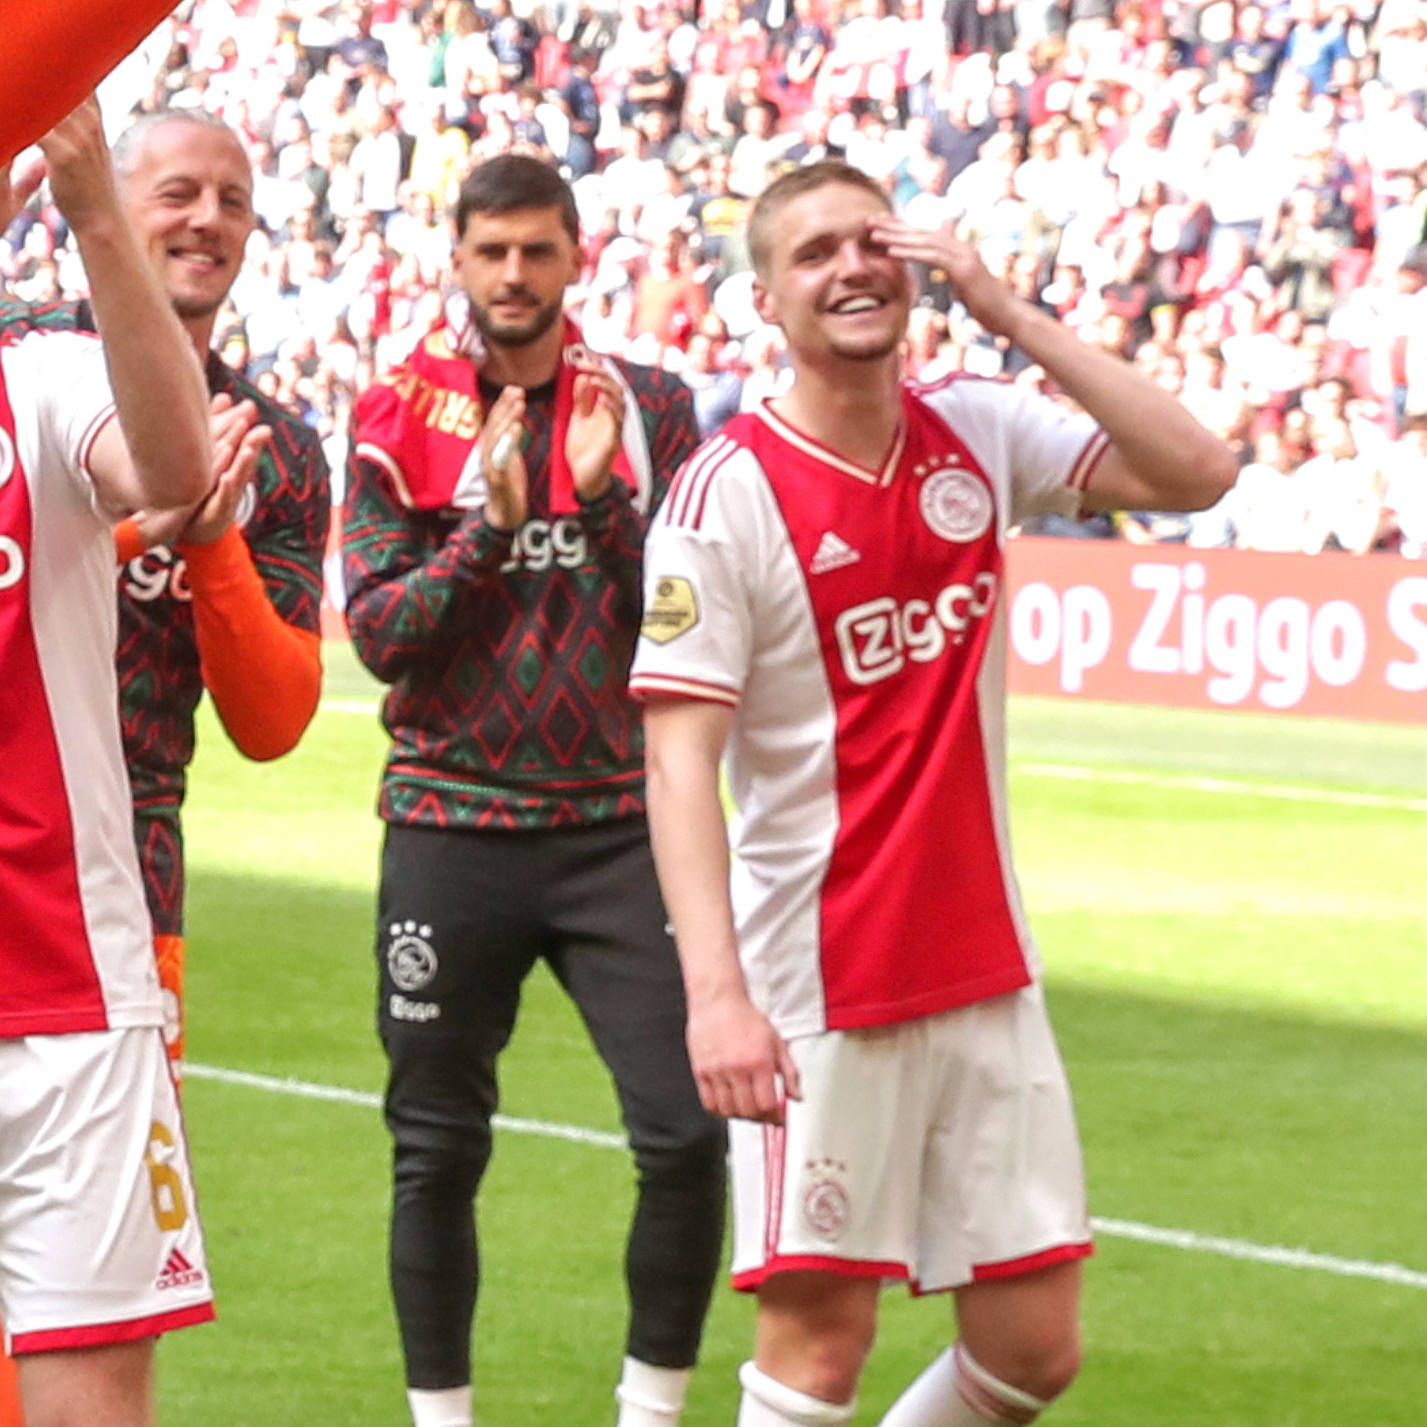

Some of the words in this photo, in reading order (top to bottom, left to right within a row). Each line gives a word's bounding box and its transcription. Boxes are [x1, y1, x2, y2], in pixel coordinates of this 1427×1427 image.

[1010, 582, 1112, 693] op
[1128, 561, 1366, 708] Ziggo
[144, 1121, 187, 1232] 6
